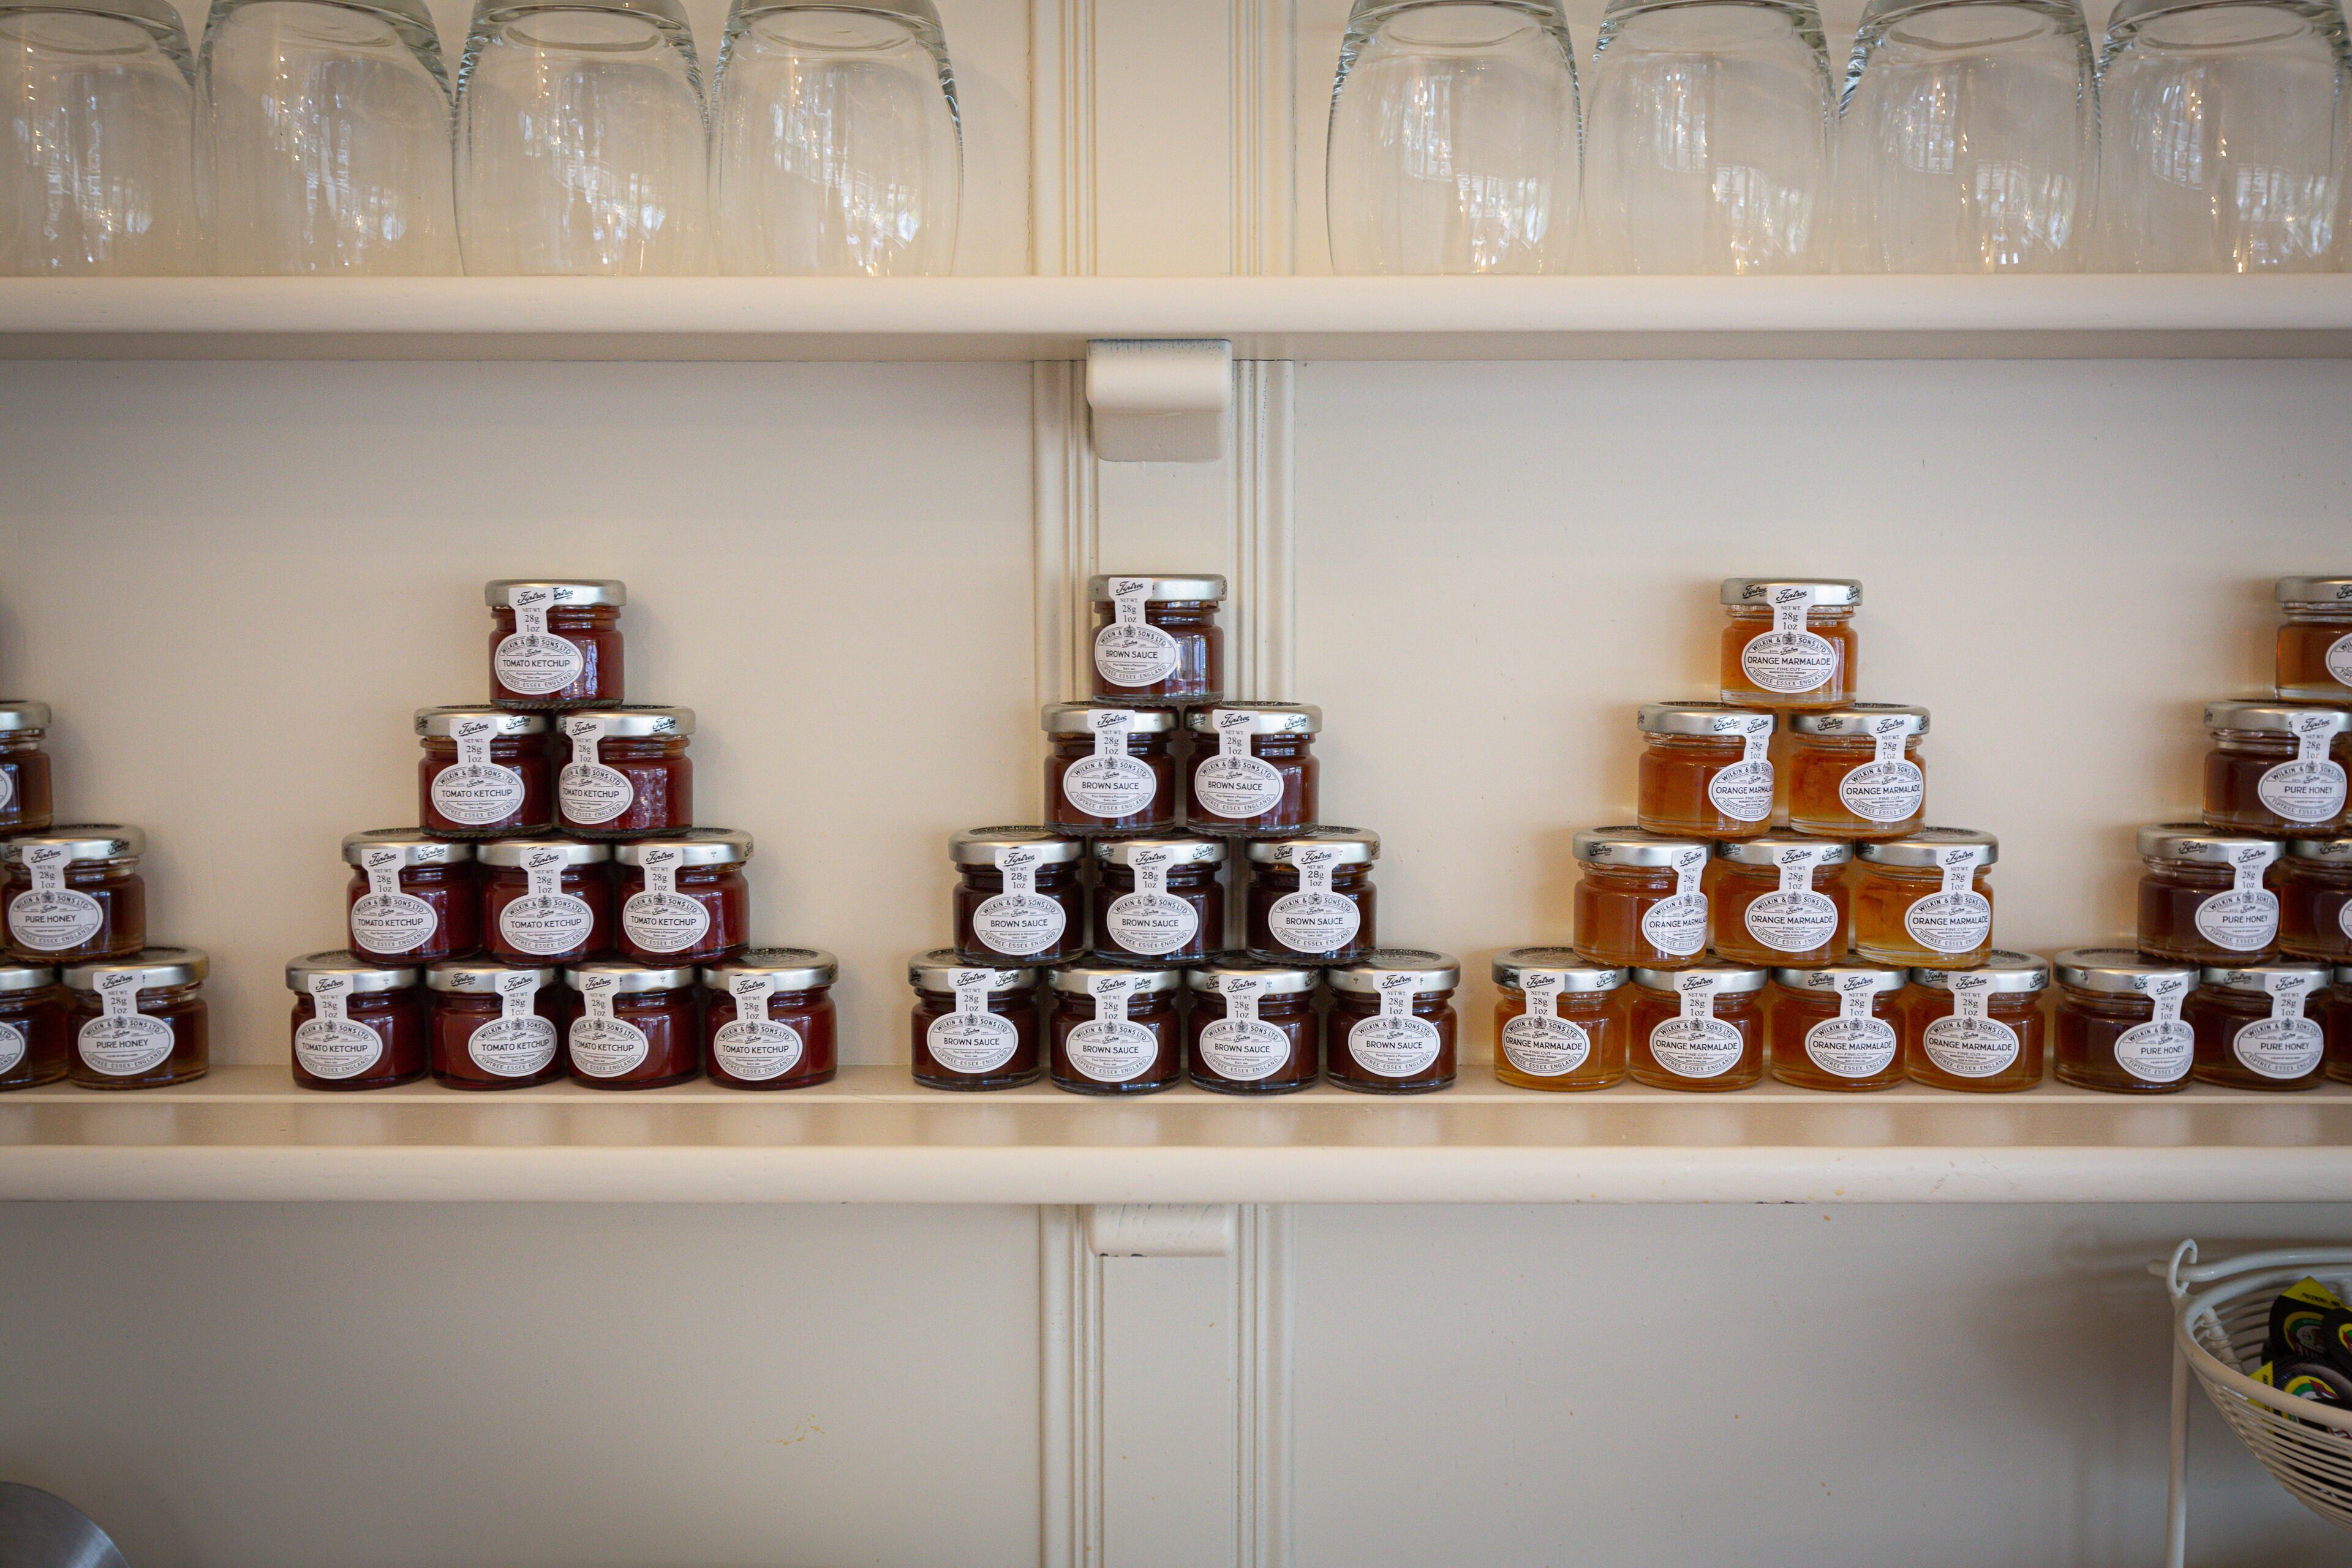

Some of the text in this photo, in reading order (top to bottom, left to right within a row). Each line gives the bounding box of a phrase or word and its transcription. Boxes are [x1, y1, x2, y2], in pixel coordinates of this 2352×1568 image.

[1115, 581, 1144, 596] Tiptree
[516, 590, 546, 606] Tiptree
[1774, 589, 1807, 603] Tiptree
[1122, 605, 1136, 614] 28g
[524, 614, 540, 624] 28g
[1782, 612, 1798, 621] 28g
[1747, 656, 1779, 665] ORANGE
[1096, 713, 1127, 728] Tiptree
[1220, 713, 1250, 728] Tiptree
[1746, 718, 1768, 733] Tiptree
[2300, 717, 2330, 732] Tiptree
[458, 722, 489, 737] Tiptree
[571, 722, 597, 736] Tiptree
[1875, 718, 1904, 734] Tiptree
[1104, 737, 1119, 745] 28g
[1227, 737, 1242, 746] 28g
[1751, 741, 1762, 750] 28g
[1883, 742, 1897, 750] 28g
[2305, 741, 2320, 750] 28g
[466, 745, 482, 754] 28g
[578, 745, 591, 755] 28g
[1208, 780, 1234, 789] BROWN
[1883, 784, 1921, 794] MARMALADE
[563, 788, 619, 798] TOMATO KETCHUP
[31, 848, 61, 863] Tiptree
[368, 852, 396, 867] Tiptree
[528, 853, 559, 868] Tiptree
[645, 850, 674, 864] Tiptree
[1003, 852, 1035, 867] Tiptree
[1134, 851, 1166, 865] Tiptree
[1300, 850, 1332, 865] Tiptree
[1679, 851, 1702, 867] Tiptree
[1781, 849, 1812, 864] Tiptree
[1945, 850, 1973, 865] Tiptree
[2237, 849, 2266, 863] Tiptree
[39, 871, 55, 880] 28g
[376, 875, 391, 884] 28g
[536, 876, 552, 884] 28g
[652, 873, 667, 882] 28g
[1011, 872, 1027, 881] 28g
[1142, 871, 1158, 881] 28g
[1308, 870, 1324, 880] 28g
[1683, 874, 1695, 883] 28g
[1788, 872, 1803, 881] 28g
[1951, 873, 1965, 881] 28g
[2242, 871, 2255, 880] 28g
[1115, 899, 1134, 913] WILKIN
[1159, 900, 1176, 908] SONS
[1176, 905, 1187, 914] LTD
[544, 918, 581, 927] KETCHUP
[630, 916, 657, 925] TOMATO
[1021, 919, 1047, 927] SAUCE
[1122, 918, 1150, 927] BROWN
[1751, 914, 1833, 924] ORANGE MARMALADE
[1950, 915, 1988, 925] MARMALADE
[102, 974, 133, 989] Tiptree
[585, 976, 611, 990] Tiptree
[956, 971, 986, 986] Tiptree
[1381, 974, 1412, 989] Tiptree
[1526, 974, 1555, 989] Tiptree
[1682, 976, 1713, 990] Tiptree
[1842, 976, 1873, 991] Tiptree
[1954, 976, 1987, 990] Tiptree
[2274, 976, 2305, 991] Tiptree
[315, 978, 344, 993] Tiptree
[503, 976, 533, 992] Tiptree
[736, 979, 766, 994] Tiptree
[1096, 979, 1126, 993] Tiptree
[1227, 978, 1257, 993] Tiptree
[2156, 980, 2182, 995] Tiptree
[322, 1001, 337, 1010] 28g
[510, 998, 526, 1008] 28g
[591, 999, 605, 1008] 28g
[1103, 1001, 1118, 1011] 28g
[1234, 1001, 1249, 1010] 28g
[1389, 997, 1403, 1006] 28g
[1532, 997, 1548, 1006] 28g
[1689, 999, 1705, 1008] 28g
[1850, 999, 1864, 1008] 28g
[1962, 998, 1978, 1008] 28g
[2281, 999, 2296, 1008] 28g
[744, 1003, 759, 1011] 28g
[2160, 1003, 2174, 1012] 28g
[119, 1039, 148, 1048] HONEY
[516, 1039, 549, 1050] KETCHUP
[944, 1037, 971, 1046] BROWN
[1366, 1040, 1395, 1049] BROWN
[1506, 1036, 1583, 1050] ORANGE MARMALADE
[1656, 1040, 1688, 1050] ORANGE
[1813, 1041, 1892, 1050] ORANGE MARMALADE
[1929, 1039, 2012, 1051] ORANGE MARMALADE
[302, 1042, 328, 1052] TOMATO
[722, 1044, 789, 1054] TOMATO KETCHUP
[1082, 1045, 1110, 1054] BROWN
[1215, 1043, 1242, 1052] BROWN
